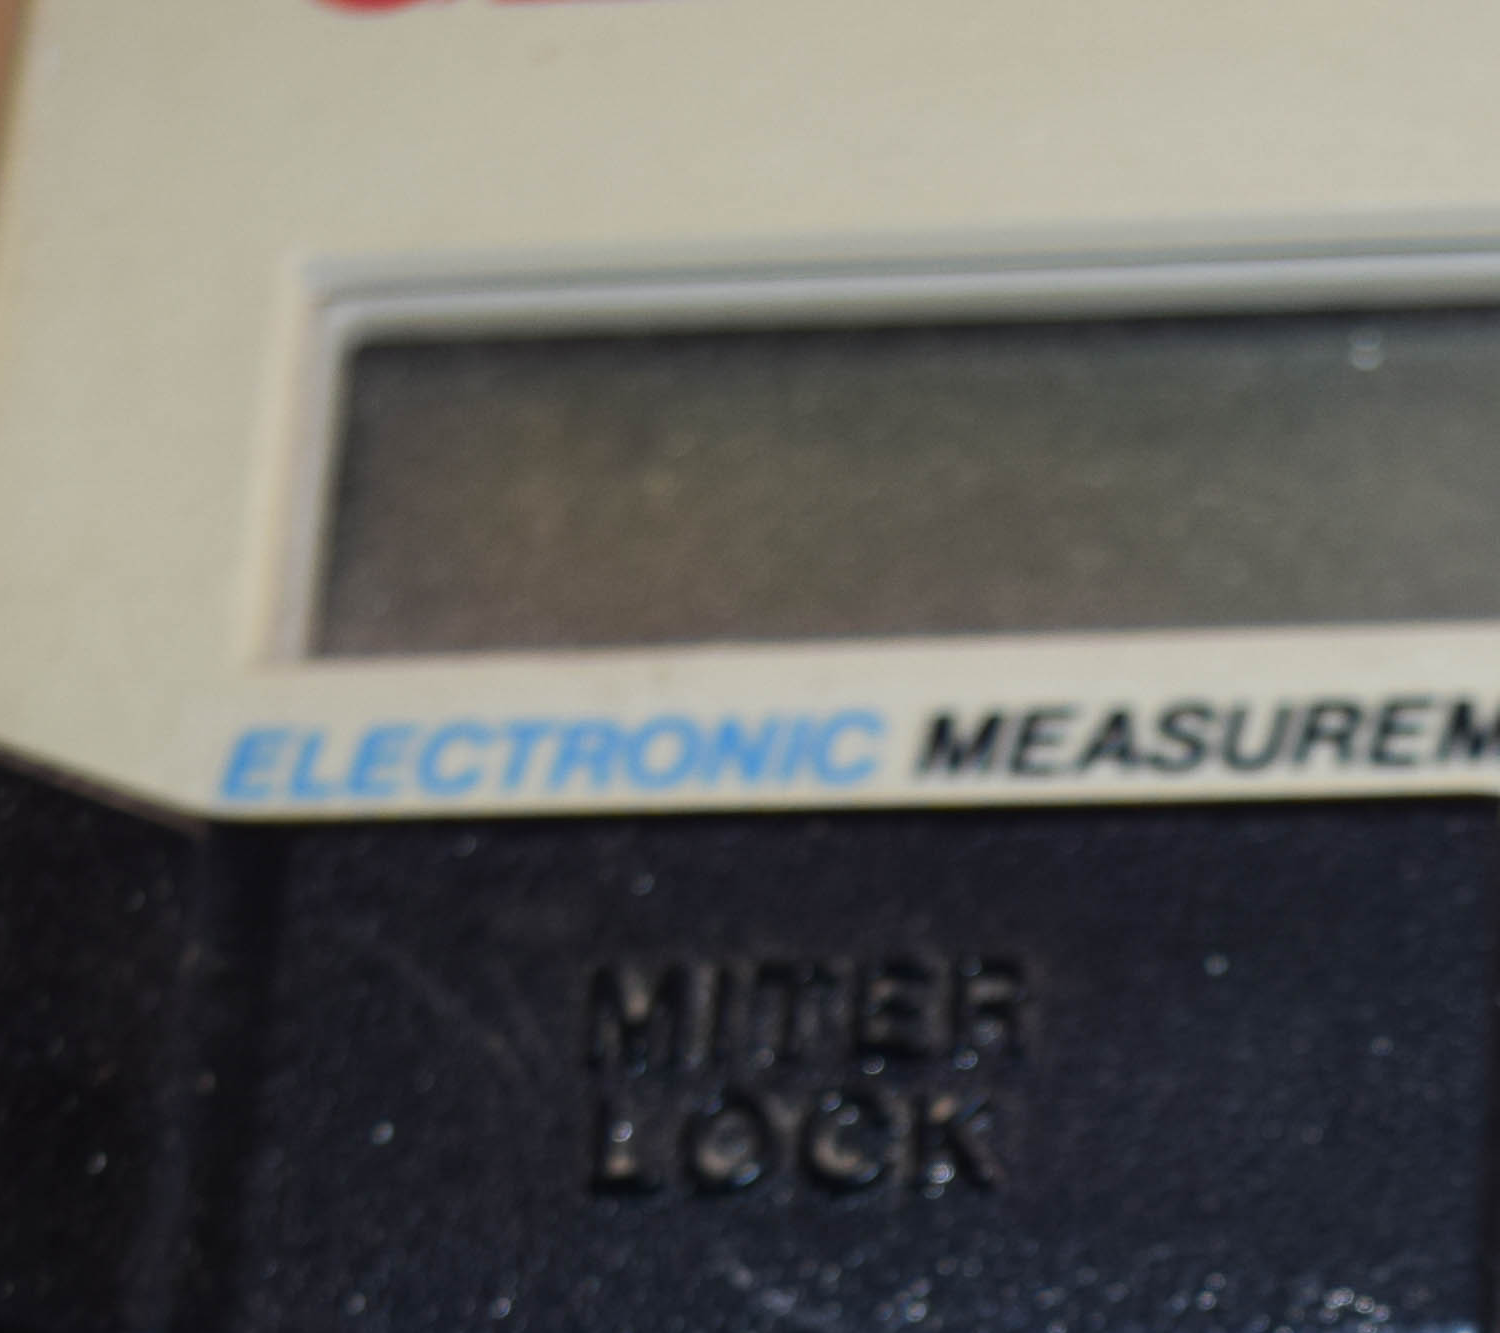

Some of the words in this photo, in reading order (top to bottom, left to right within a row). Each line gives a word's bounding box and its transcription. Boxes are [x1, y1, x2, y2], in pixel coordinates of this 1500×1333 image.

[218, 710, 886, 804] ELECTRONIC
[584, 956, 1032, 1072] MITER
[584, 1084, 1000, 1198] LOCK
